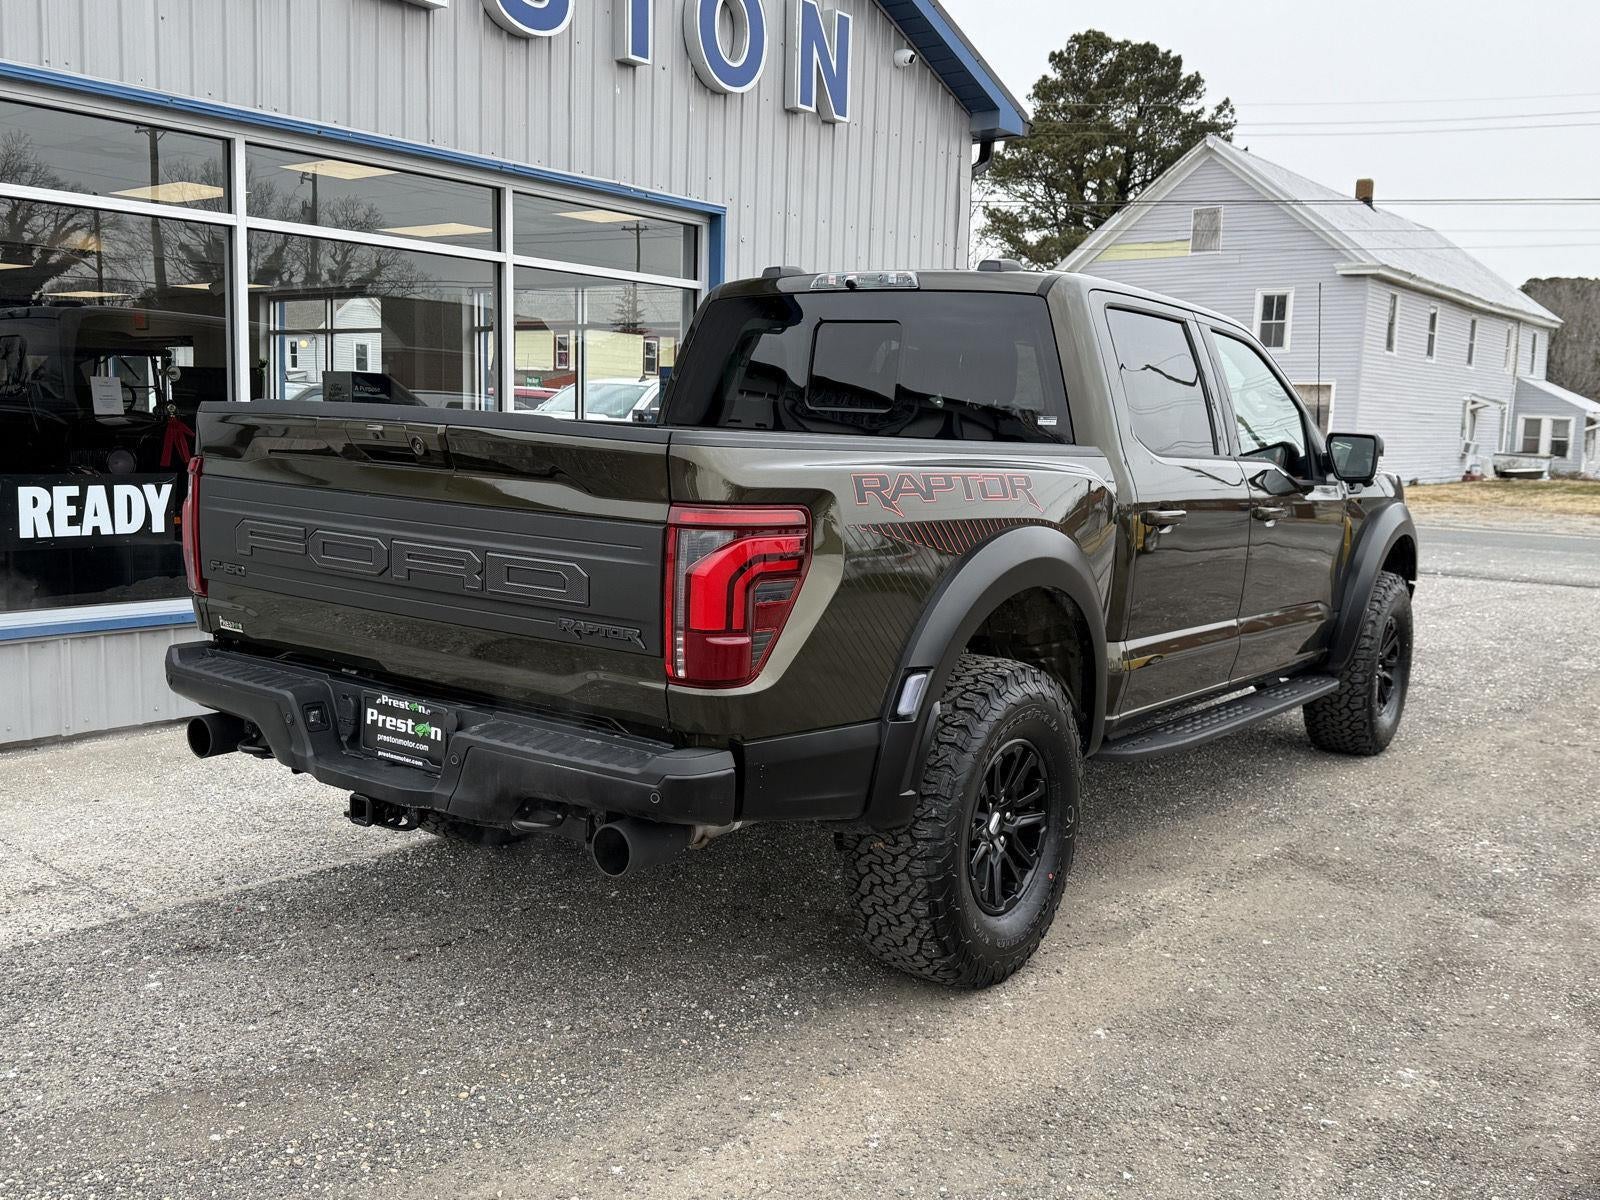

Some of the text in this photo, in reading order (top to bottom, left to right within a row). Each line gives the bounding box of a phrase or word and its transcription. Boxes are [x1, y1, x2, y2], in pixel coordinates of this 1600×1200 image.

[18, 484, 172, 539] READY
[850, 473, 1044, 517] RAPTOR
[210, 560, 246, 577] F-150
[235, 518, 590, 607] FORD
[559, 618, 647, 650] RAPTOR
[377, 734, 429, 752] prestonmotor.com
